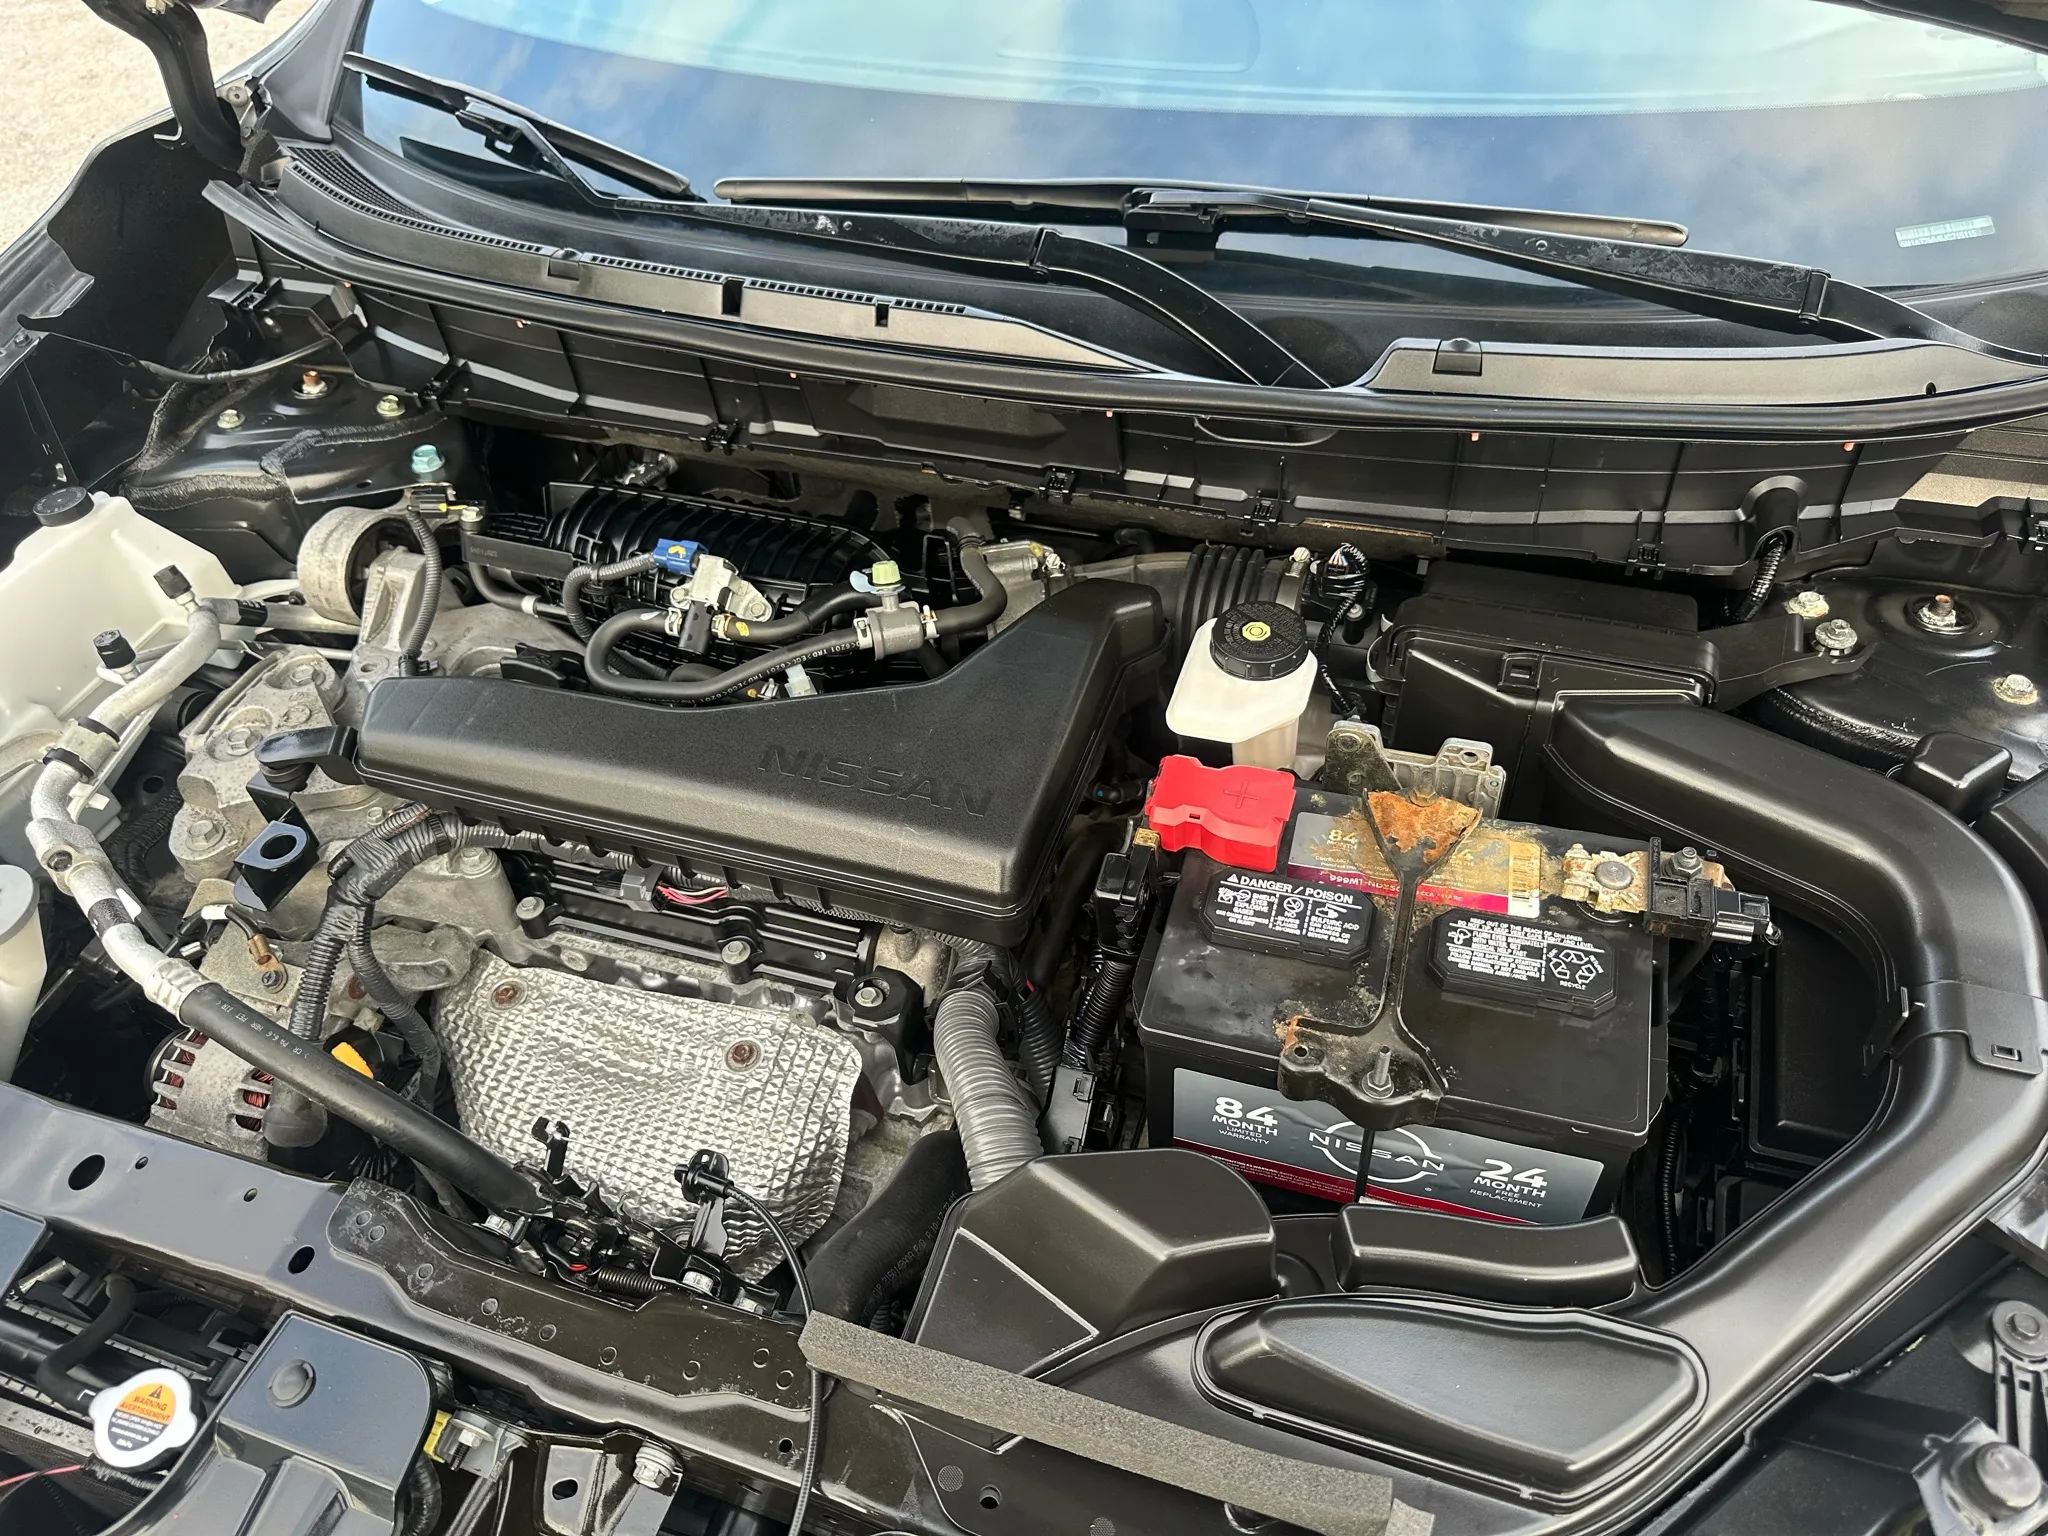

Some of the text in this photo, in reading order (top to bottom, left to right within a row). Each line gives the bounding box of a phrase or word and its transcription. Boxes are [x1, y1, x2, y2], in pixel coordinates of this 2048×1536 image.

[758, 745, 991, 817] NISSAN
[1328, 829, 1359, 843] 84
[1239, 875, 1292, 892] DANGER
[1304, 887, 1353, 903] POISON
[1250, 898, 1267, 906] EYES
[1252, 892, 1274, 902] SHIELD
[1234, 900, 1269, 912] EXPLOSIVE
[1310, 915, 1359, 930] SULFURIC ACID
[1522, 926, 1542, 935] REACH
[1553, 932, 1582, 942] CHILDREN
[1576, 941, 1594, 949] LEVEL
[1512, 949, 1526, 957] FAST
[1560, 981, 1586, 990] RECYCLE
[1214, 1096, 1278, 1127] 84
[1212, 1114, 1278, 1136] MONTH
[1226, 1126, 1262, 1138] LIMITED
[1219, 1129, 1270, 1145] WARRANTY
[1308, 1132, 1444, 1172] NISSAN
[1479, 1158, 1548, 1188] 24
[1473, 1176, 1546, 1198] MONTH
[1495, 1189, 1520, 1198] FREE
[1469, 1188, 1543, 1208] REPLACEMENT
[134, 1396, 168, 1411] WARNING
